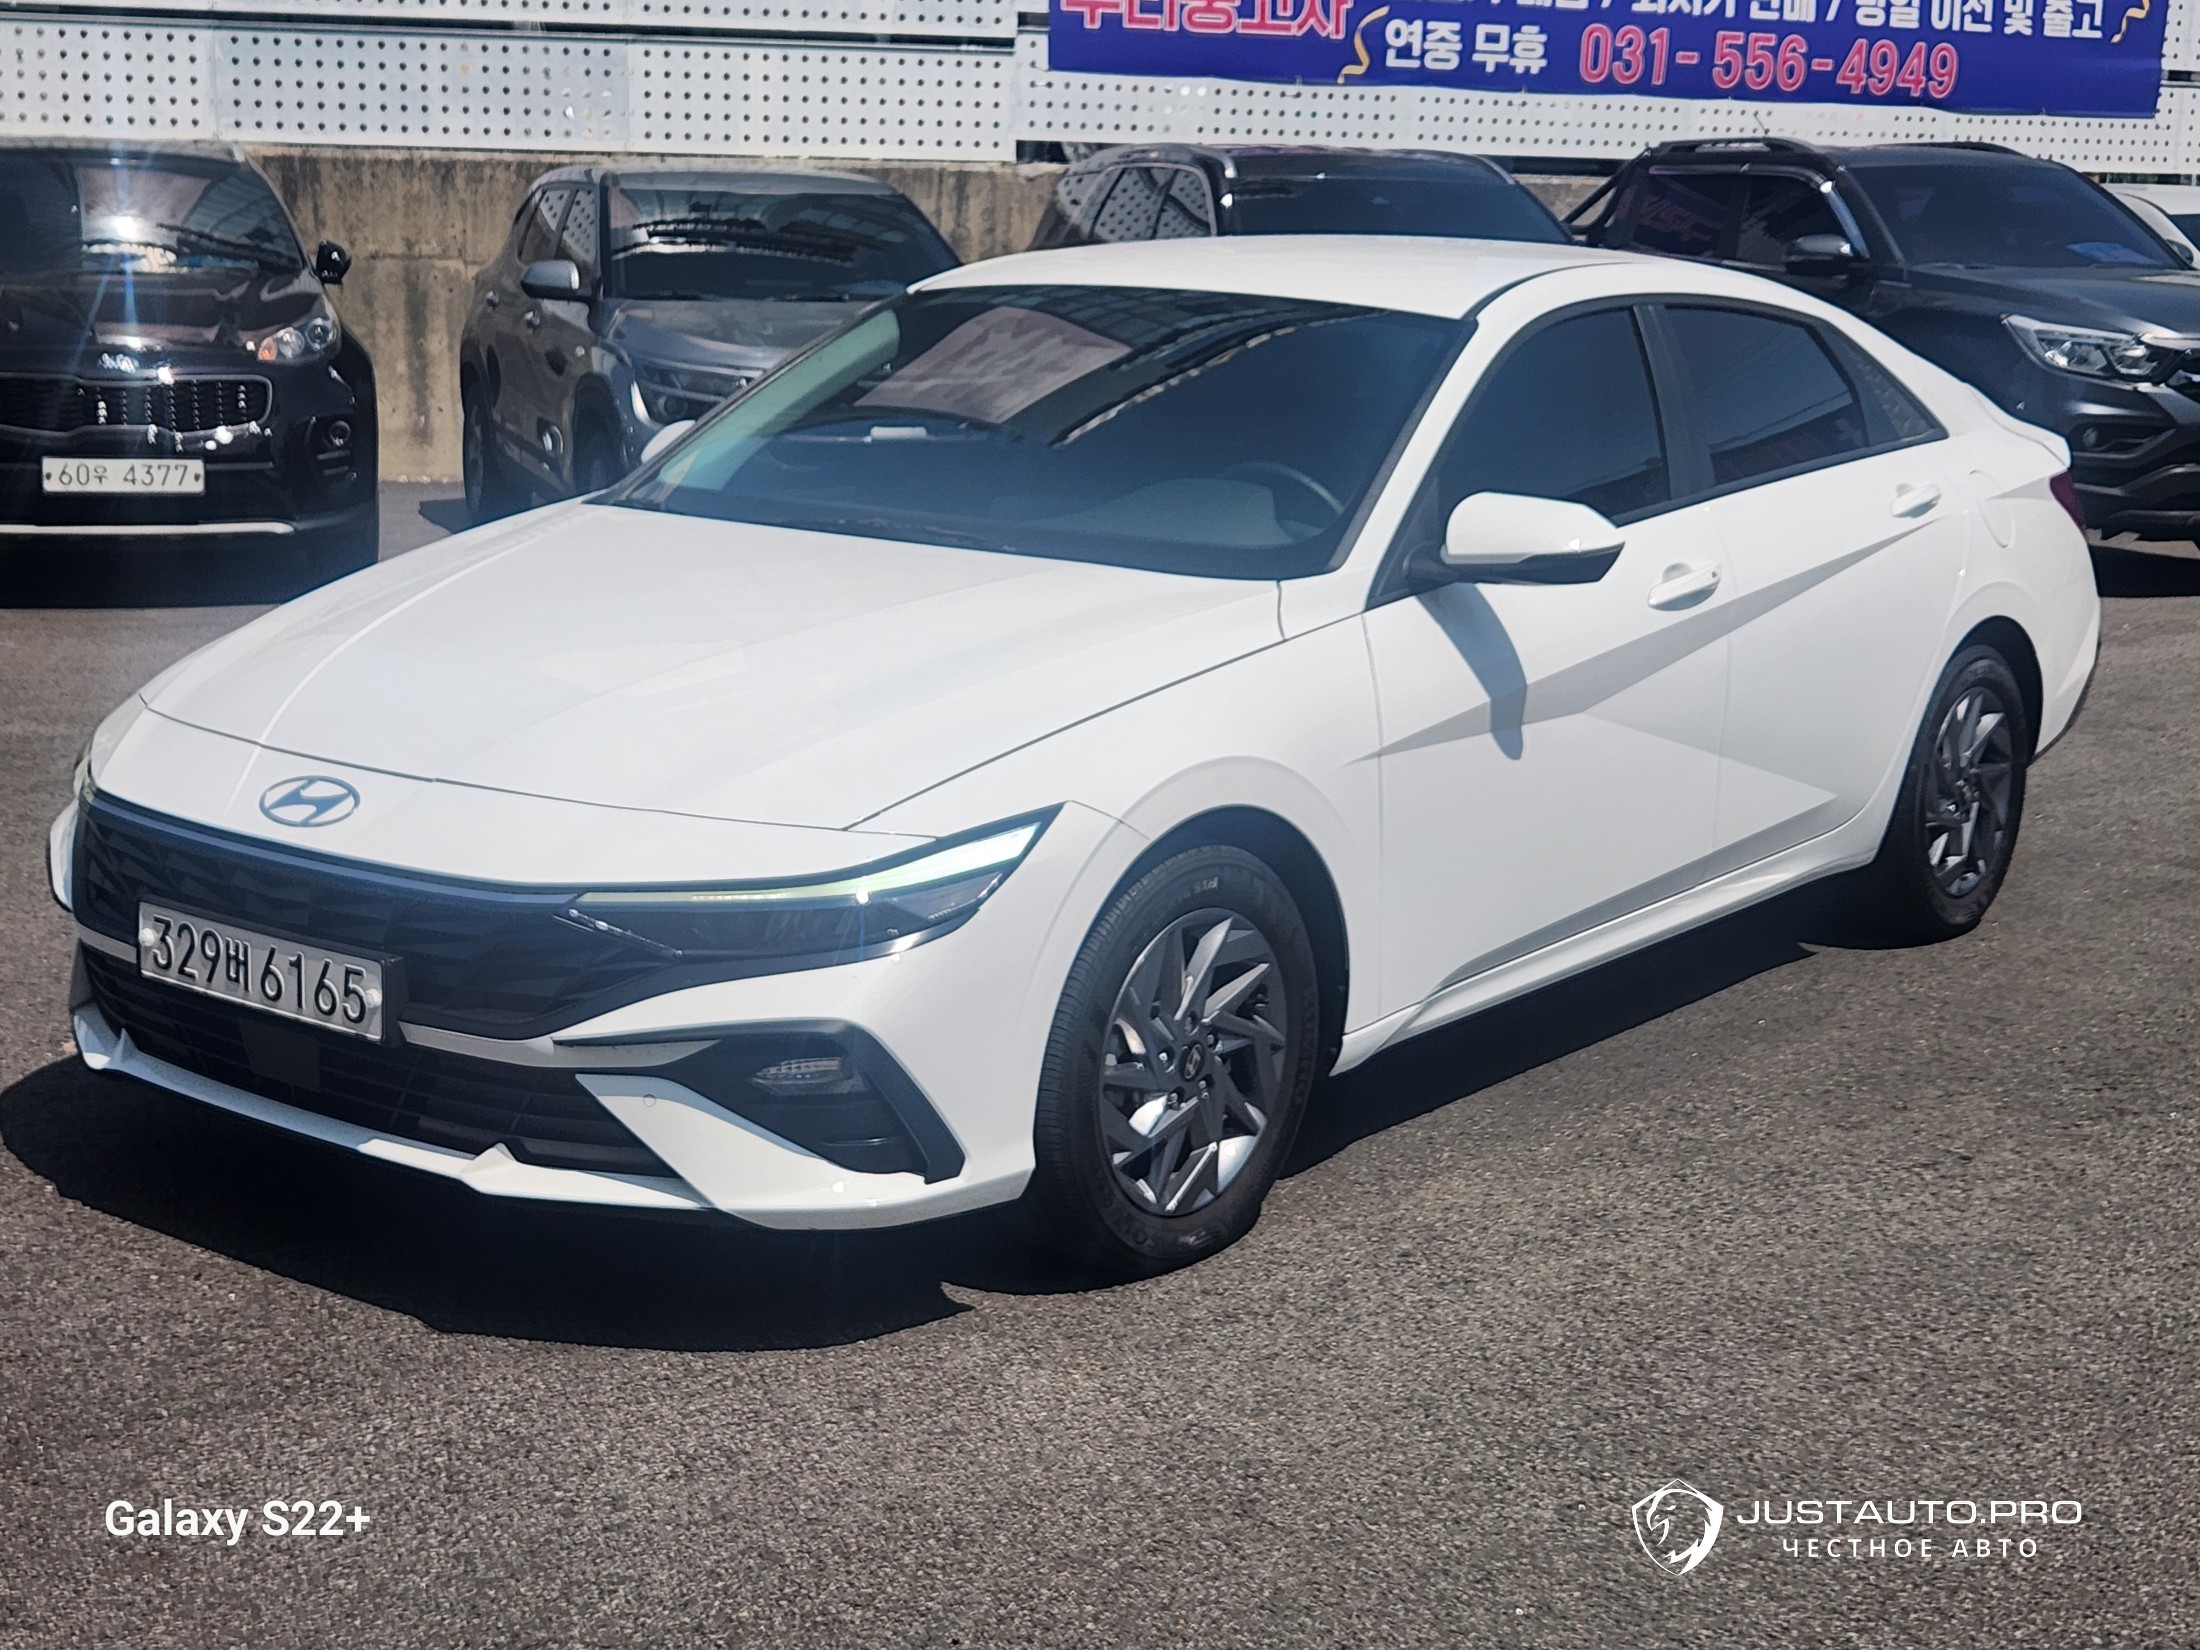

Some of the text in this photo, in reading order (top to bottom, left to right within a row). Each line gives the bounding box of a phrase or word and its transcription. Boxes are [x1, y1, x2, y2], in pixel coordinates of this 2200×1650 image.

[1384, 18, 1463, 71] 연중
[1471, 23, 1549, 75] 무휴
[123, 464, 189, 487] 4377
[260, 945, 368, 1024] 6165
